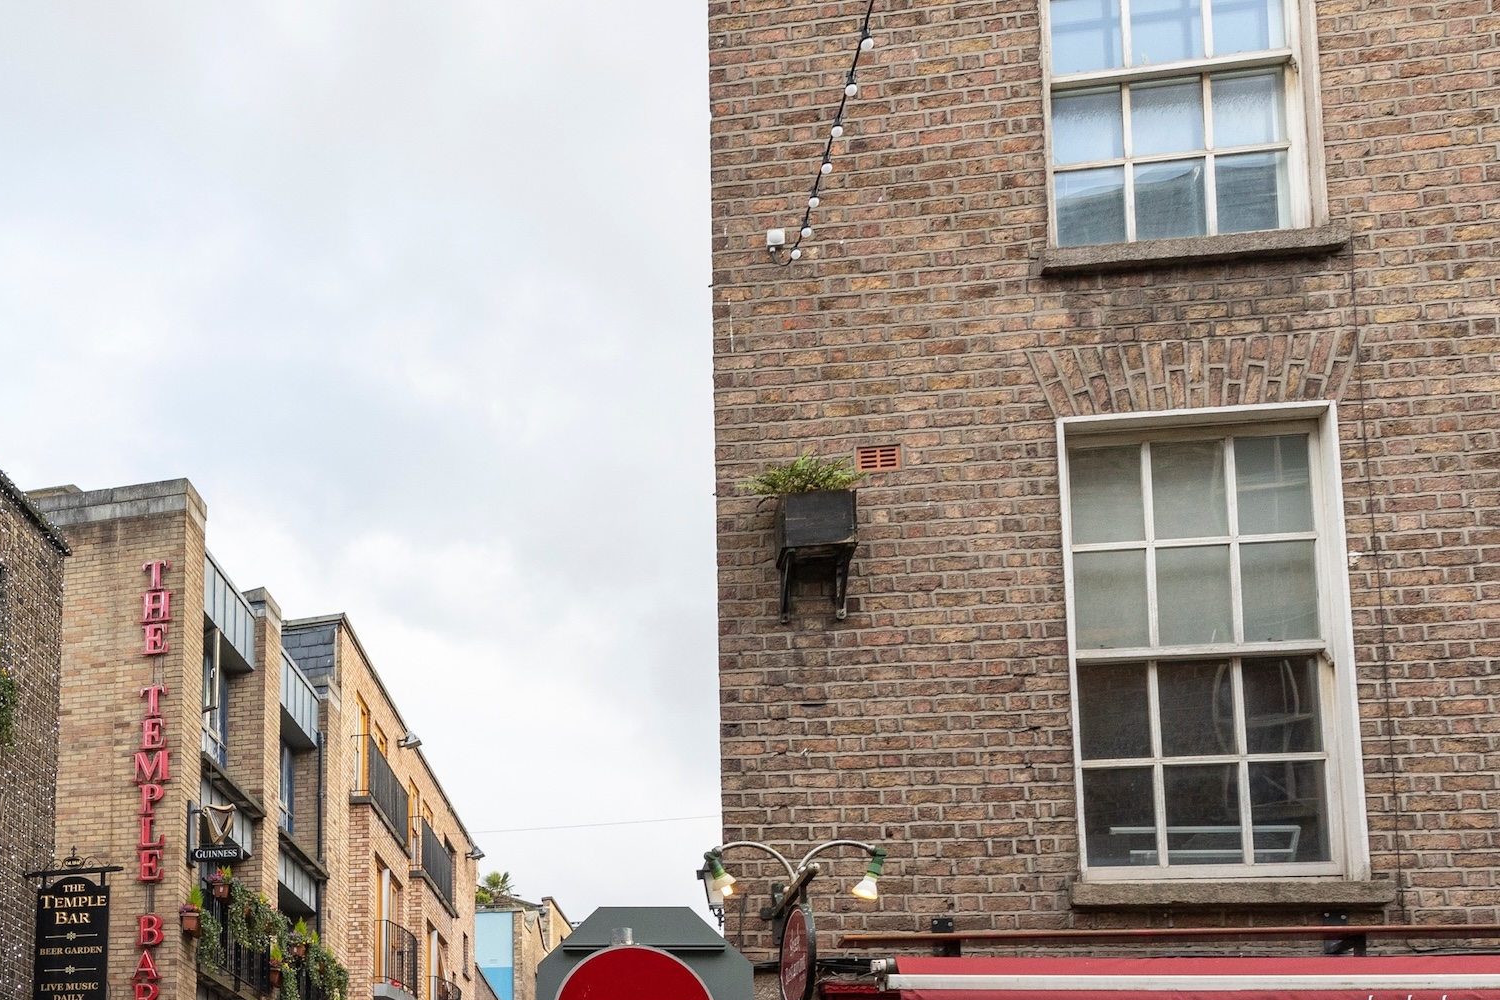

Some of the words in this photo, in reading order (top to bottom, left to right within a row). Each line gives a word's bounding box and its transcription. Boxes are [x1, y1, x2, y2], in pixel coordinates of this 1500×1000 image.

[140, 560, 172, 655] THE
[131, 685, 172, 882] TEMPLE
[195, 848, 238, 859] GUINNESS
[62, 884, 85, 893] THE
[40, 895, 107, 909] TEMPLE
[55, 912, 91, 925] BAR
[40, 948, 63, 956] BEER
[64, 946, 103, 955] GARDEN
[40, 983, 64, 992] LIVE
[65, 982, 99, 991] MUSIC
